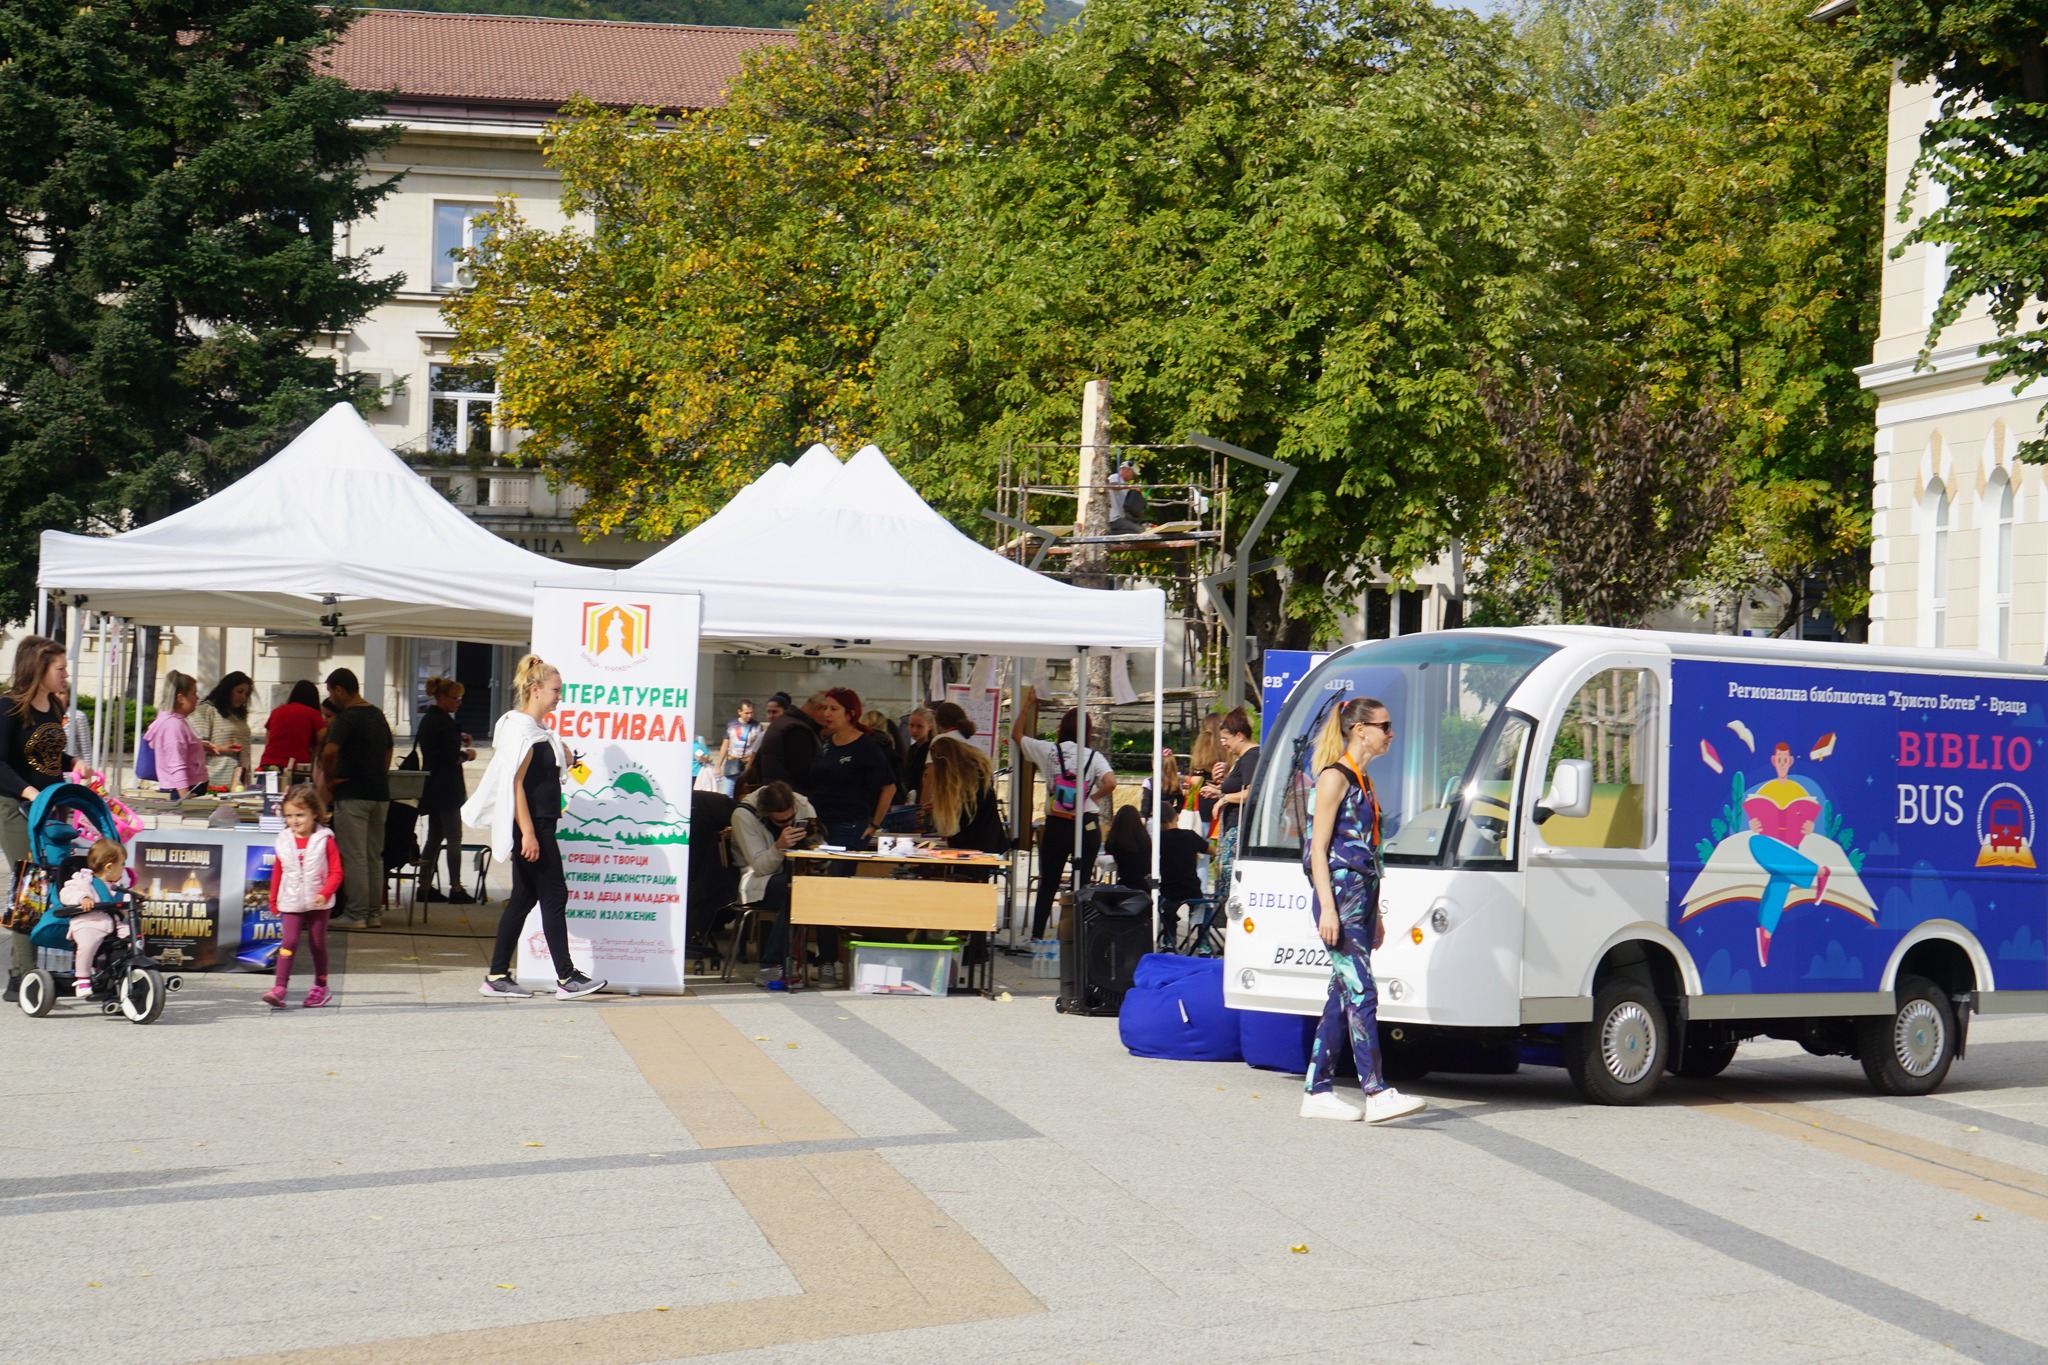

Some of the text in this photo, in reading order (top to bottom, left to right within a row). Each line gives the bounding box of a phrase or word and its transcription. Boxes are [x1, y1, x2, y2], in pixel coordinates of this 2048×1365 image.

[1728, 682, 1808, 702] Регионална
[1810, 686, 1886, 706] библиотека
[1990, 697, 2027, 716] Враца
[1897, 731, 2032, 772] BIBLIO
[1897, 783, 1964, 826] BUS
[145, 848, 166, 862] ТОМ
[568, 853, 649, 867] СРЕЩИ С ТВОРЦИ
[603, 873, 677, 886] ДЕМОНСТРАЦИИ
[583, 891, 594, 901] ЗА
[597, 892, 622, 902] ДЕЦА
[624, 893, 631, 902] И
[633, 893, 680, 904] МЛАДЕЖИ
[1248, 892, 1308, 910] BIBLIO
[142, 901, 207, 917] ЗАВЕТЪТ НА
[565, 908, 657, 921] НИЖНО ИЗЛОЖЕНИЕ
[140, 917, 213, 938] ОСТРАДАМУС
[252, 922, 284, 940] ЛАЗ
